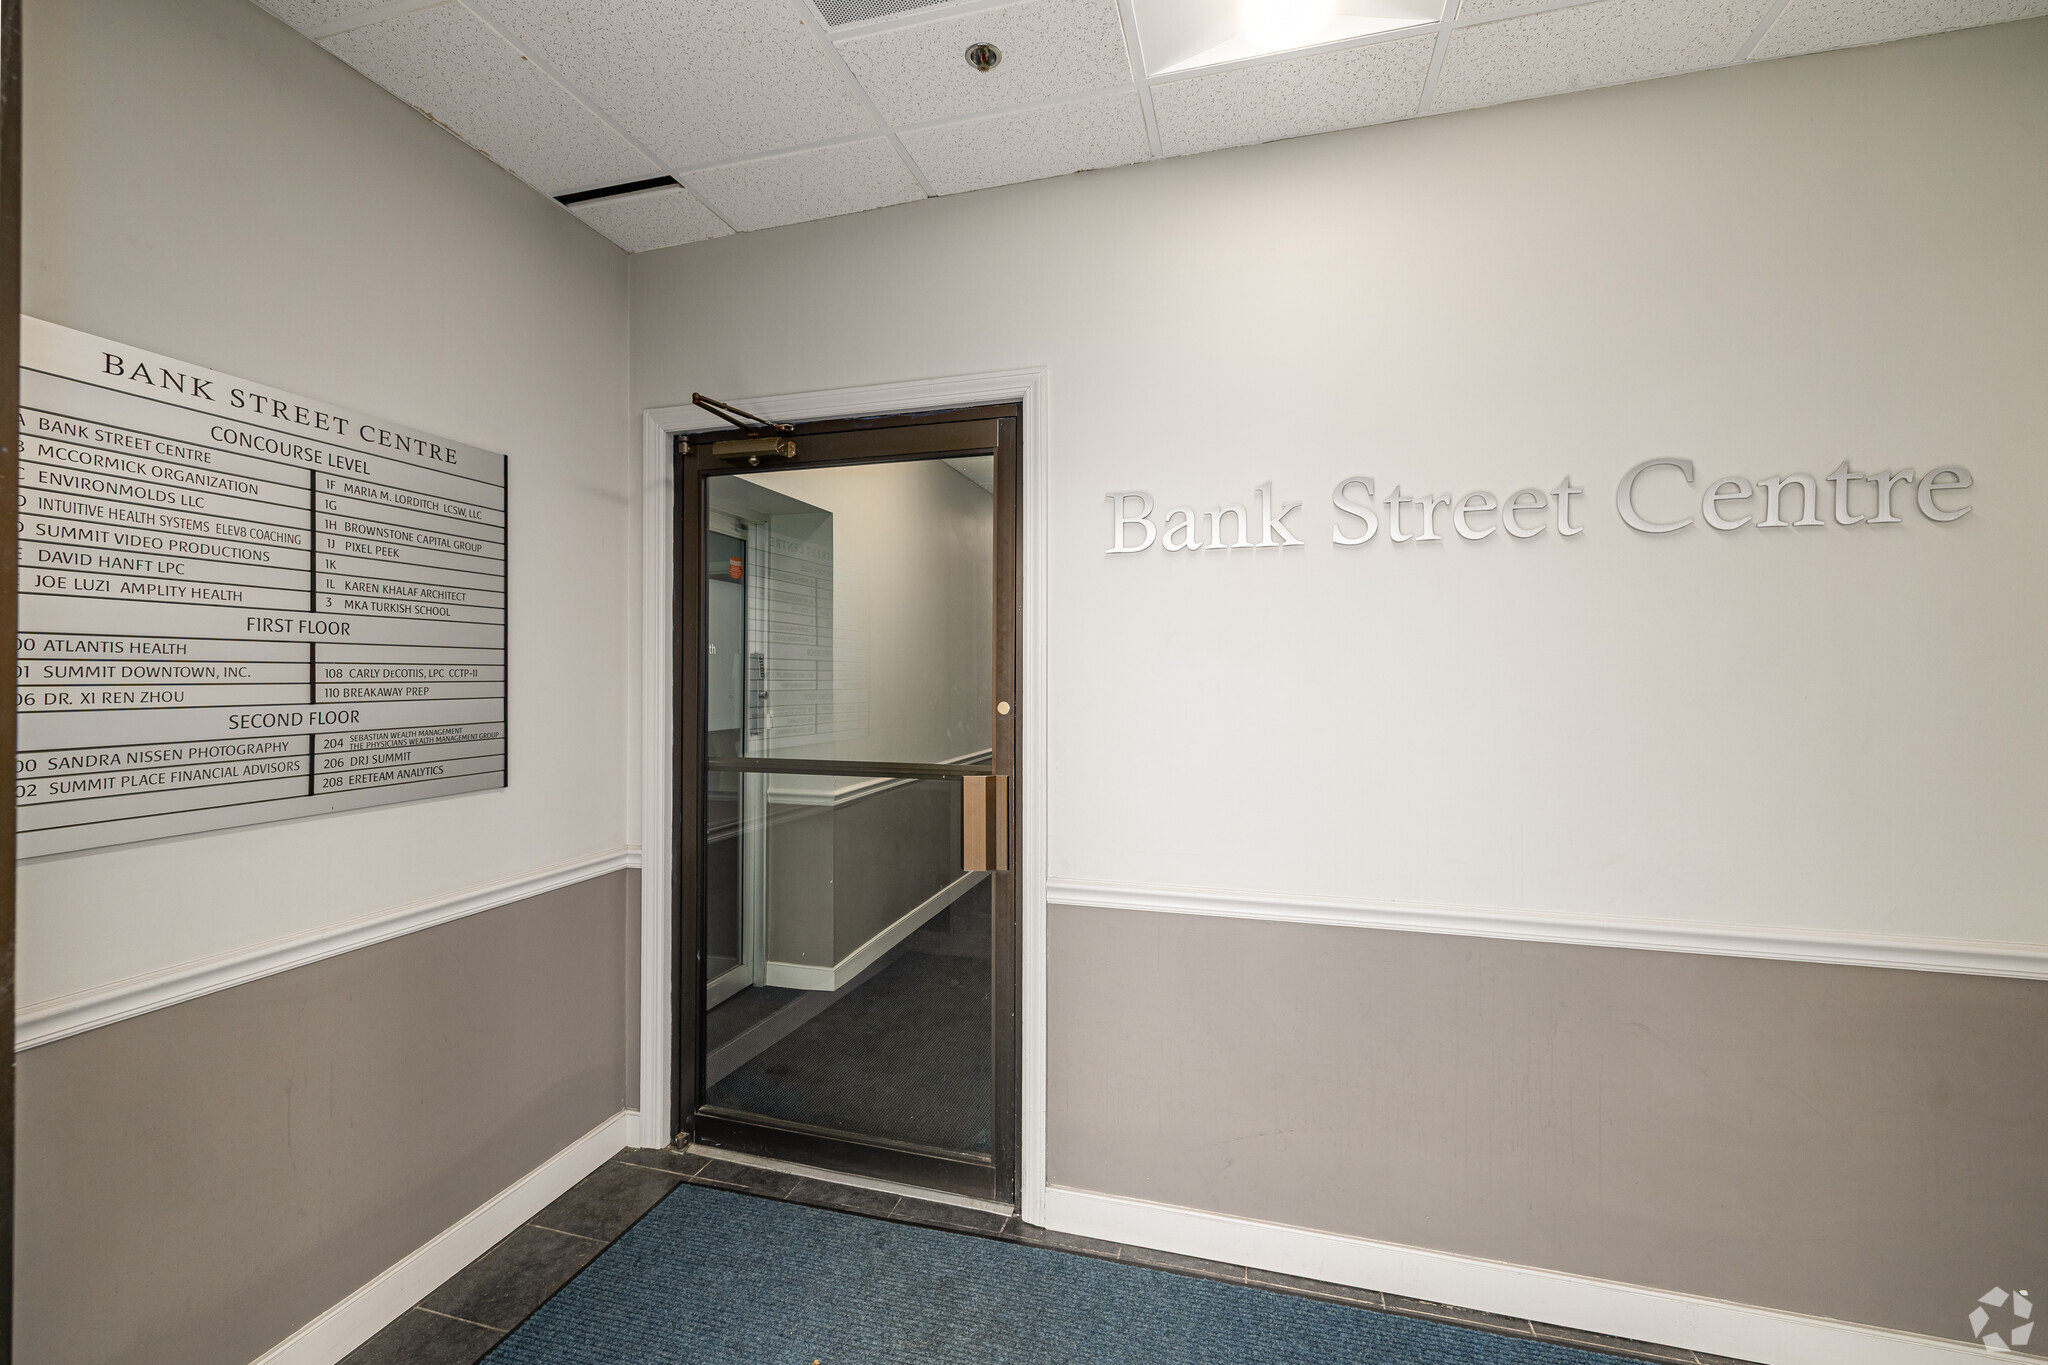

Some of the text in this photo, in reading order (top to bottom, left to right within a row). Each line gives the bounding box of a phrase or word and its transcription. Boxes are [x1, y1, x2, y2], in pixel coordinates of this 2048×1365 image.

[102, 352, 457, 464] BANK STREET CENTRE
[39, 418, 89, 439] BANK
[95, 430, 152, 451] STREET
[156, 442, 211, 463] CENTRE
[211, 426, 370, 475] CONCOURSE LEVEL
[38, 444, 146, 475] MCCORMICK
[151, 466, 258, 495] ORGANIZATION
[39, 471, 175, 503] ENVIRONMOLDS
[181, 494, 204, 508] LLC
[326, 479, 482, 519] 1F MARIA M. LORDITCH LCSW, LLC
[325, 499, 337, 510] 1G
[1105, 457, 1974, 555] Bank Street Centre
[39, 497, 104, 518] INTUITIVE
[109, 508, 155, 525] HEALTH
[160, 515, 209, 532] SYSTEMS
[216, 523, 247, 537] ELEV8
[250, 528, 301, 545] COACHING
[36, 523, 109, 543] SUMMIT
[114, 533, 163, 549] VIDEO
[169, 540, 269, 561] PRODUCTIONS
[325, 519, 482, 552] 1H BROWNSTONE CAPITAL GROUP
[327, 539, 399, 558] 1J PIXEL PEEK
[39, 550, 92, 565] DAVID
[99, 556, 153, 571] HANFT
[158, 562, 184, 575] LPC
[325, 559, 336, 569] 1K
[35, 575, 66, 589] JOE
[75, 578, 109, 592] LUZI
[120, 582, 186, 597] AMPLITY
[192, 588, 242, 601] HEALTH
[326, 579, 466, 601] 1L KAREN KHALAF ARCHITECT
[325, 597, 450, 616] 3 MKA TURKISH SCHOOL
[247, 617, 350, 635] FIRST FLOOR
[43, 640, 124, 653] ATLANTIS
[130, 642, 186, 654] HEALTH
[44, 666, 116, 678] SUMMIT
[122, 666, 219, 679] DOWNTOWN,
[224, 667, 250, 677] INC.
[325, 669, 343, 678] 108
[349, 669, 380, 678] CARLY
[429, 669, 444, 677] LPC
[449, 669, 477, 678] CCTP-II
[45, 693, 72, 705] DR.
[80, 693, 95, 704] XI
[102, 692, 134, 704] REN
[140, 691, 184, 703] ZHOU
[325, 687, 429, 698] 110 BREAKAWAY PREP
[229, 710, 359, 729] SECOND FLOOR
[323, 738, 345, 749] 204
[48, 754, 121, 770] SANDRA
[127, 749, 182, 764] NISSEN
[189, 741, 289, 759] PHOTOGRAPHY
[324, 752, 412, 769] 206 DRJ SUMMIT
[50, 777, 116, 795] SUMMIT
[121, 773, 166, 787] PLACE
[171, 766, 239, 783] FINANCIAL
[243, 761, 300, 776] ADVISORS
[323, 765, 443, 788] 208 ERETEAM ANALYTICS
